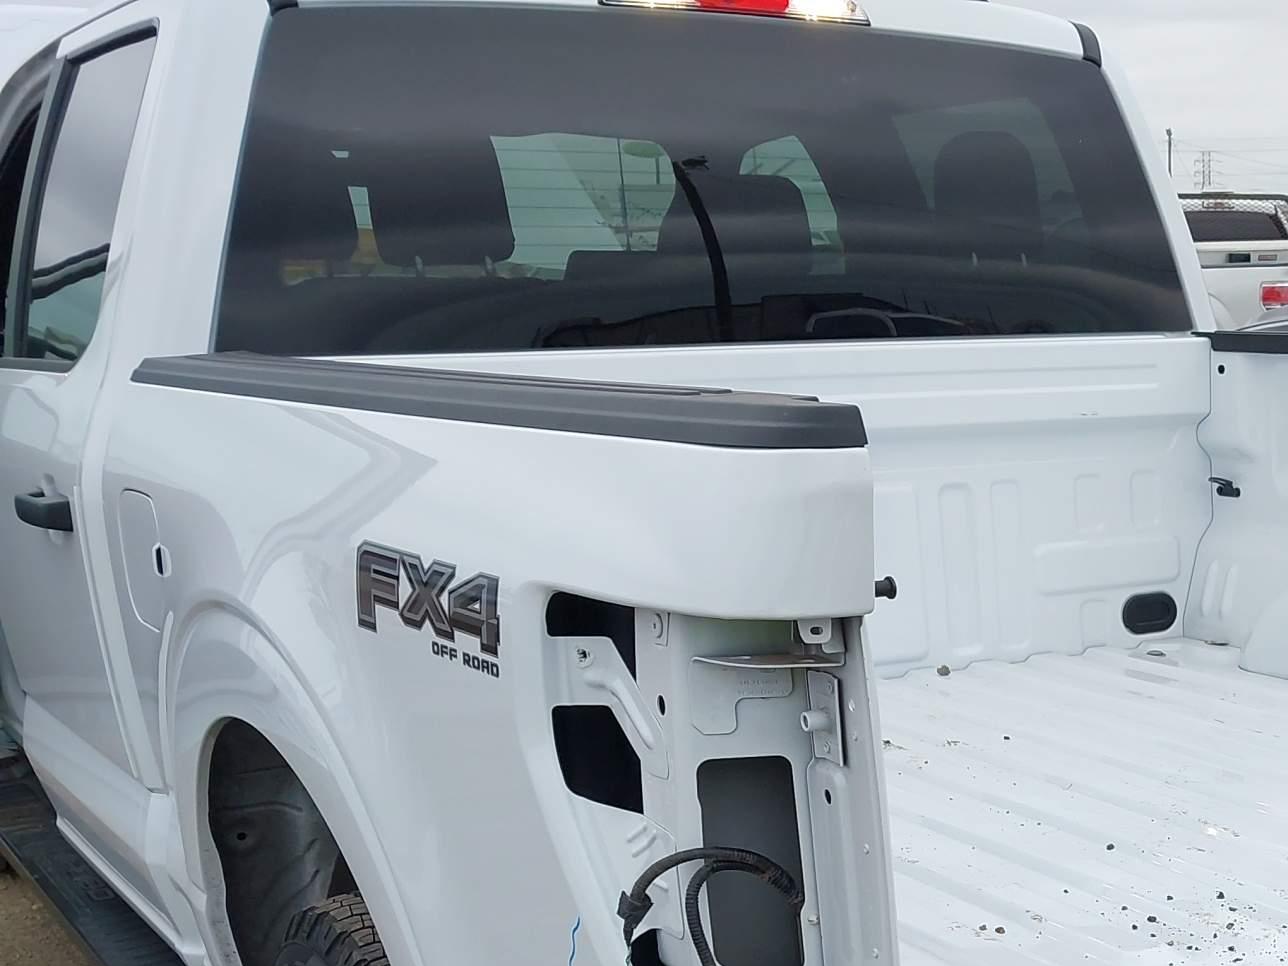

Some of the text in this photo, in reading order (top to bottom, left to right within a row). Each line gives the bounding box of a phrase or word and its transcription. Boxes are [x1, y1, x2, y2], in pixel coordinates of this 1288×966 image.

[357, 540, 500, 658] FX4
[431, 641, 500, 679] OFF ROAD
